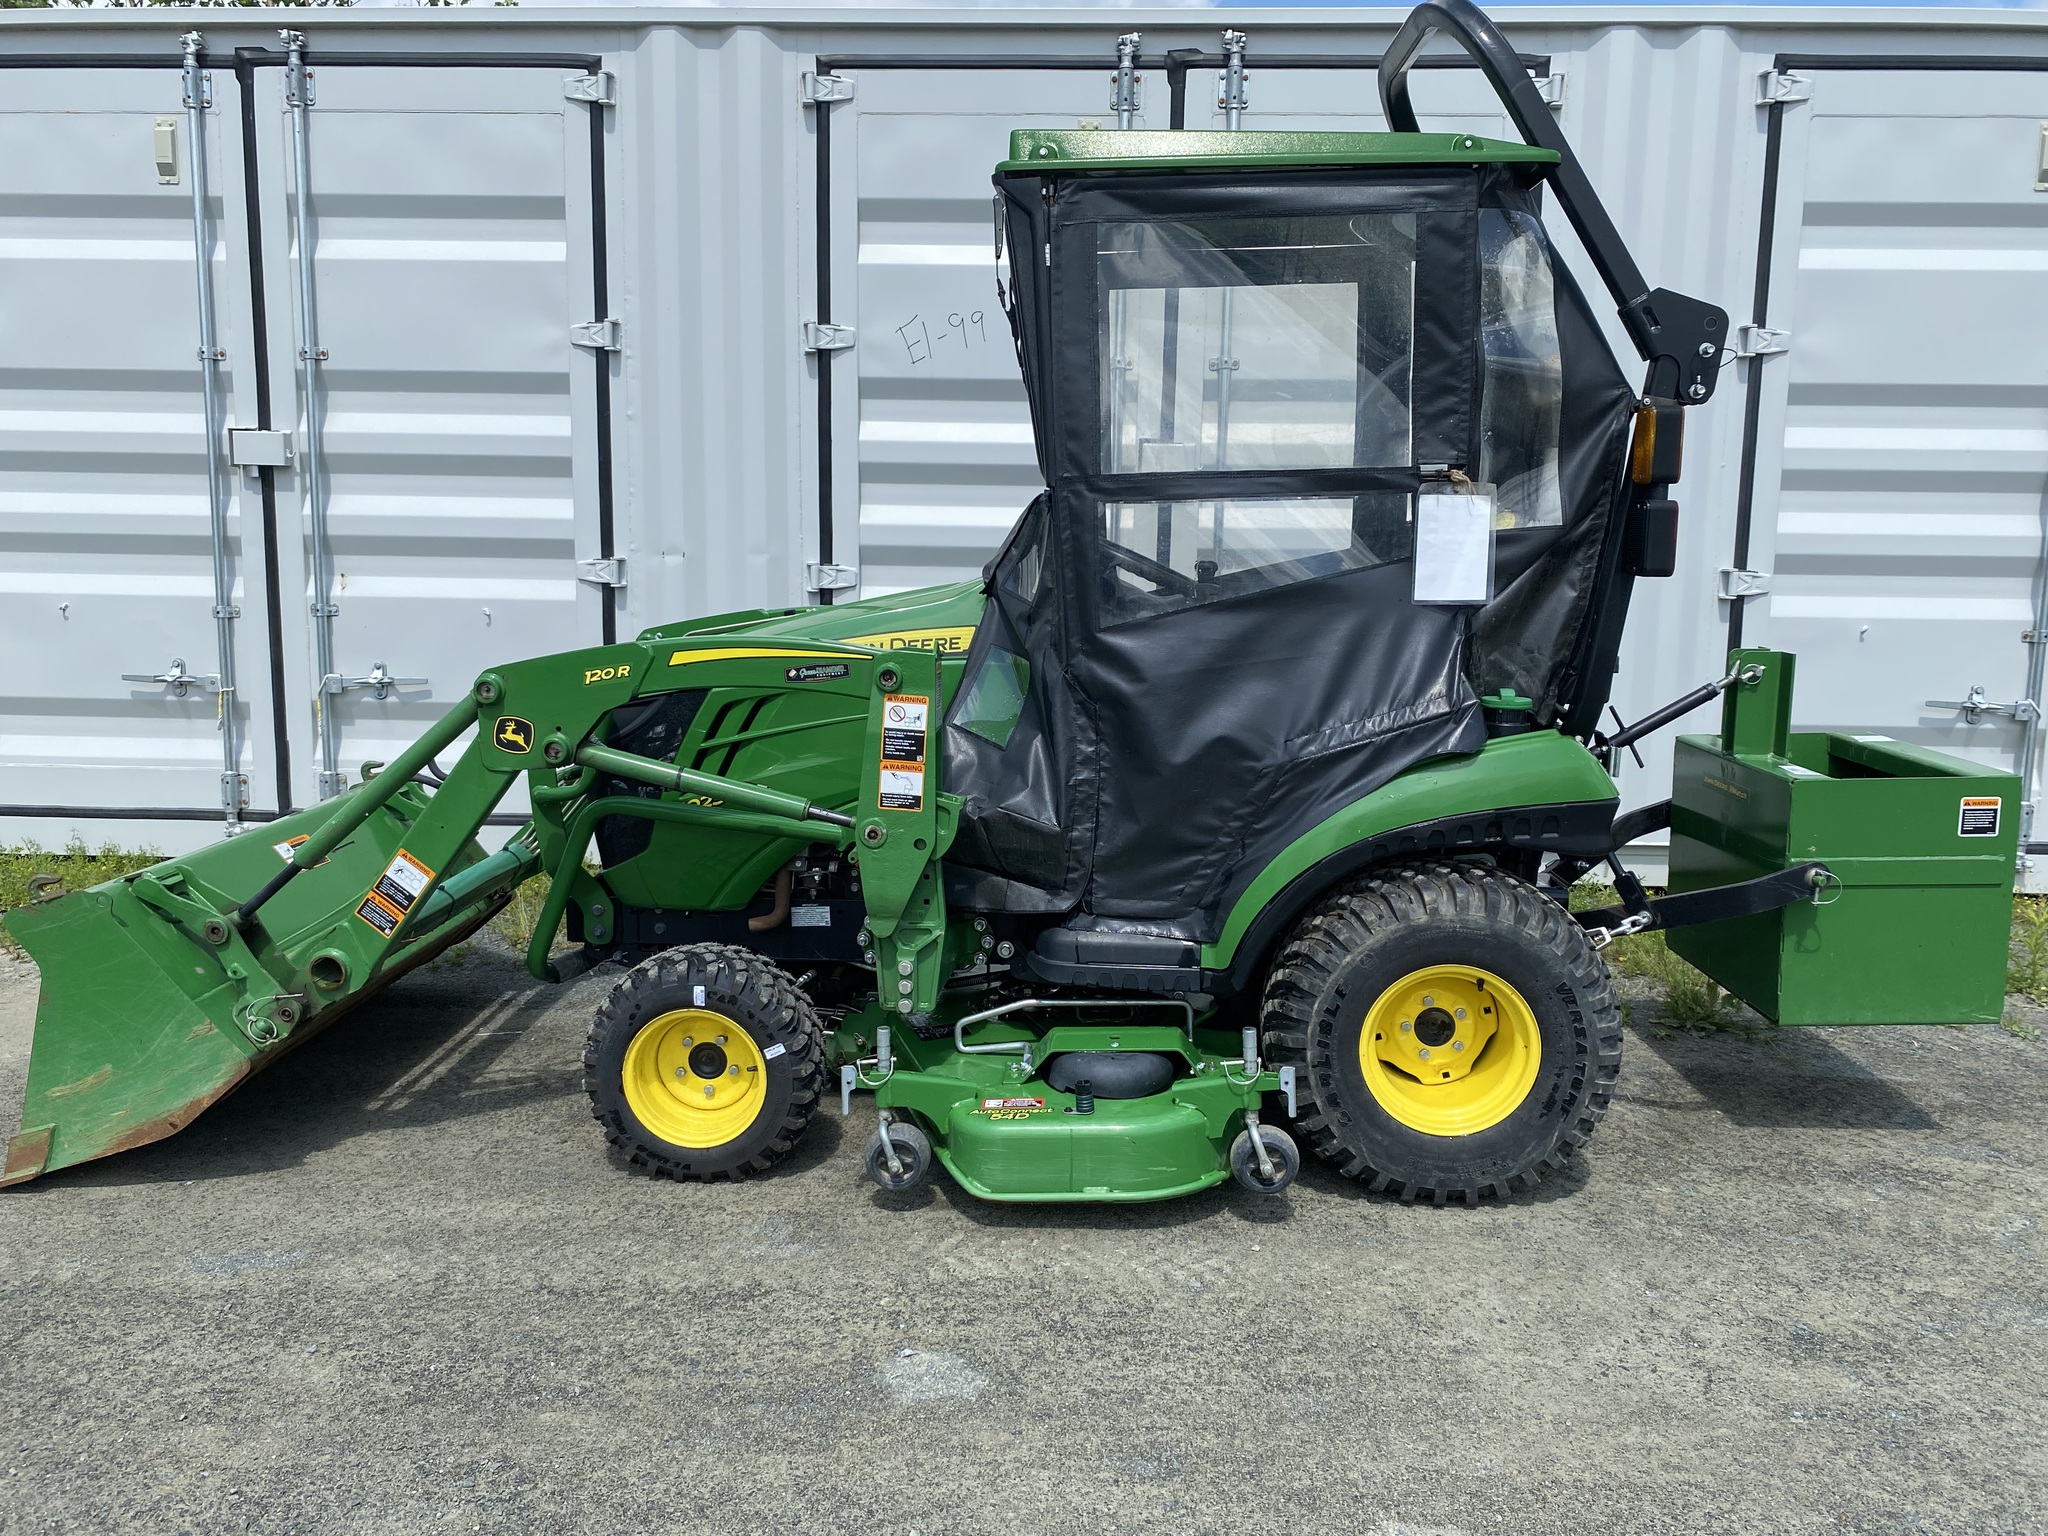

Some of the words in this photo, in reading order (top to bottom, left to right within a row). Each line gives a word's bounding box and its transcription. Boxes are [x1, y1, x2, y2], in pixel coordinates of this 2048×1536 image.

[890, 637, 962, 652] DEERE
[584, 667, 616, 686] 120
[893, 695, 928, 704] WARNING
[889, 763, 923, 772] WARNING
[407, 855, 431, 876] WARNING
[377, 900, 400, 919] WARNING
[1555, 981, 1588, 1056] VERSA
[1311, 978, 1353, 1127] CARLISLE
[1559, 1061, 1588, 1123] TURF
[968, 1107, 1054, 1115] AutoConnect
[989, 1112, 1030, 1121] 54D
